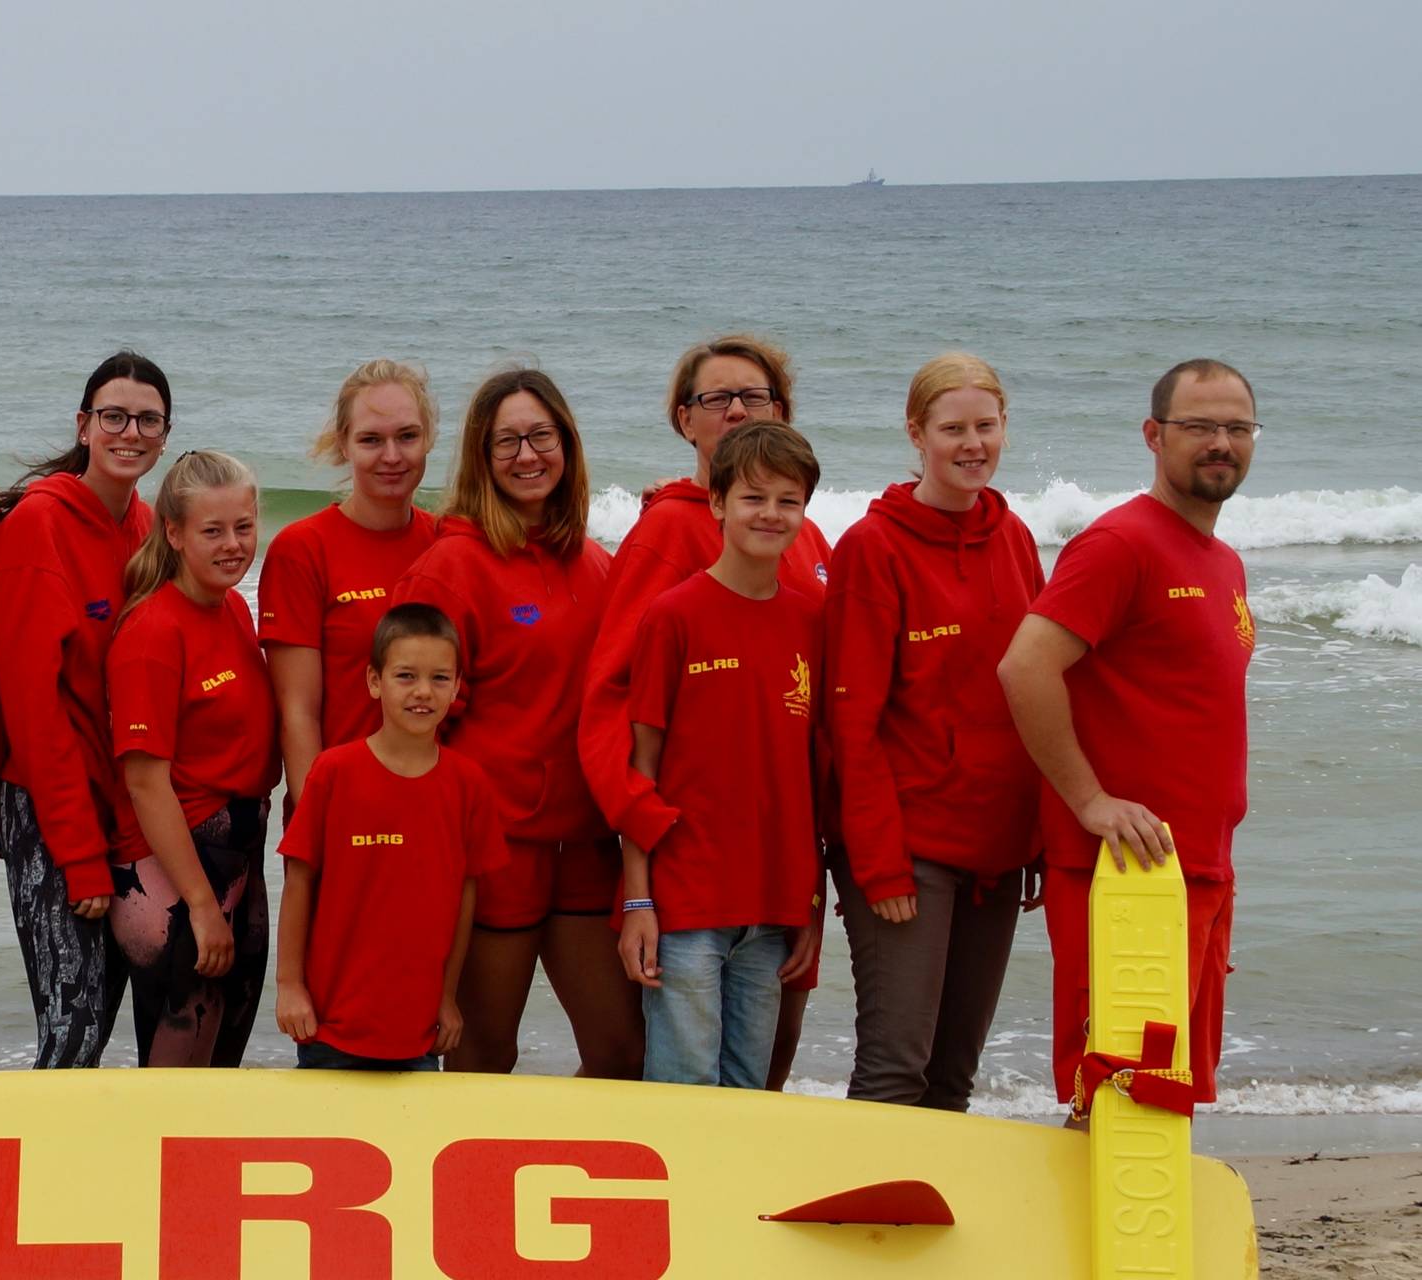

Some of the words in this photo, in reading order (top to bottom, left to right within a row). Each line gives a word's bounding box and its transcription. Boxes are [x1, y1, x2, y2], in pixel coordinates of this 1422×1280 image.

[336, 587, 387, 603] DLRG
[1167, 586, 1206, 599] DLRG
[908, 623, 962, 642] DLRG
[688, 657, 740, 674] DLRG
[201, 669, 237, 692] DLRG
[351, 833, 404, 846] DLRG
